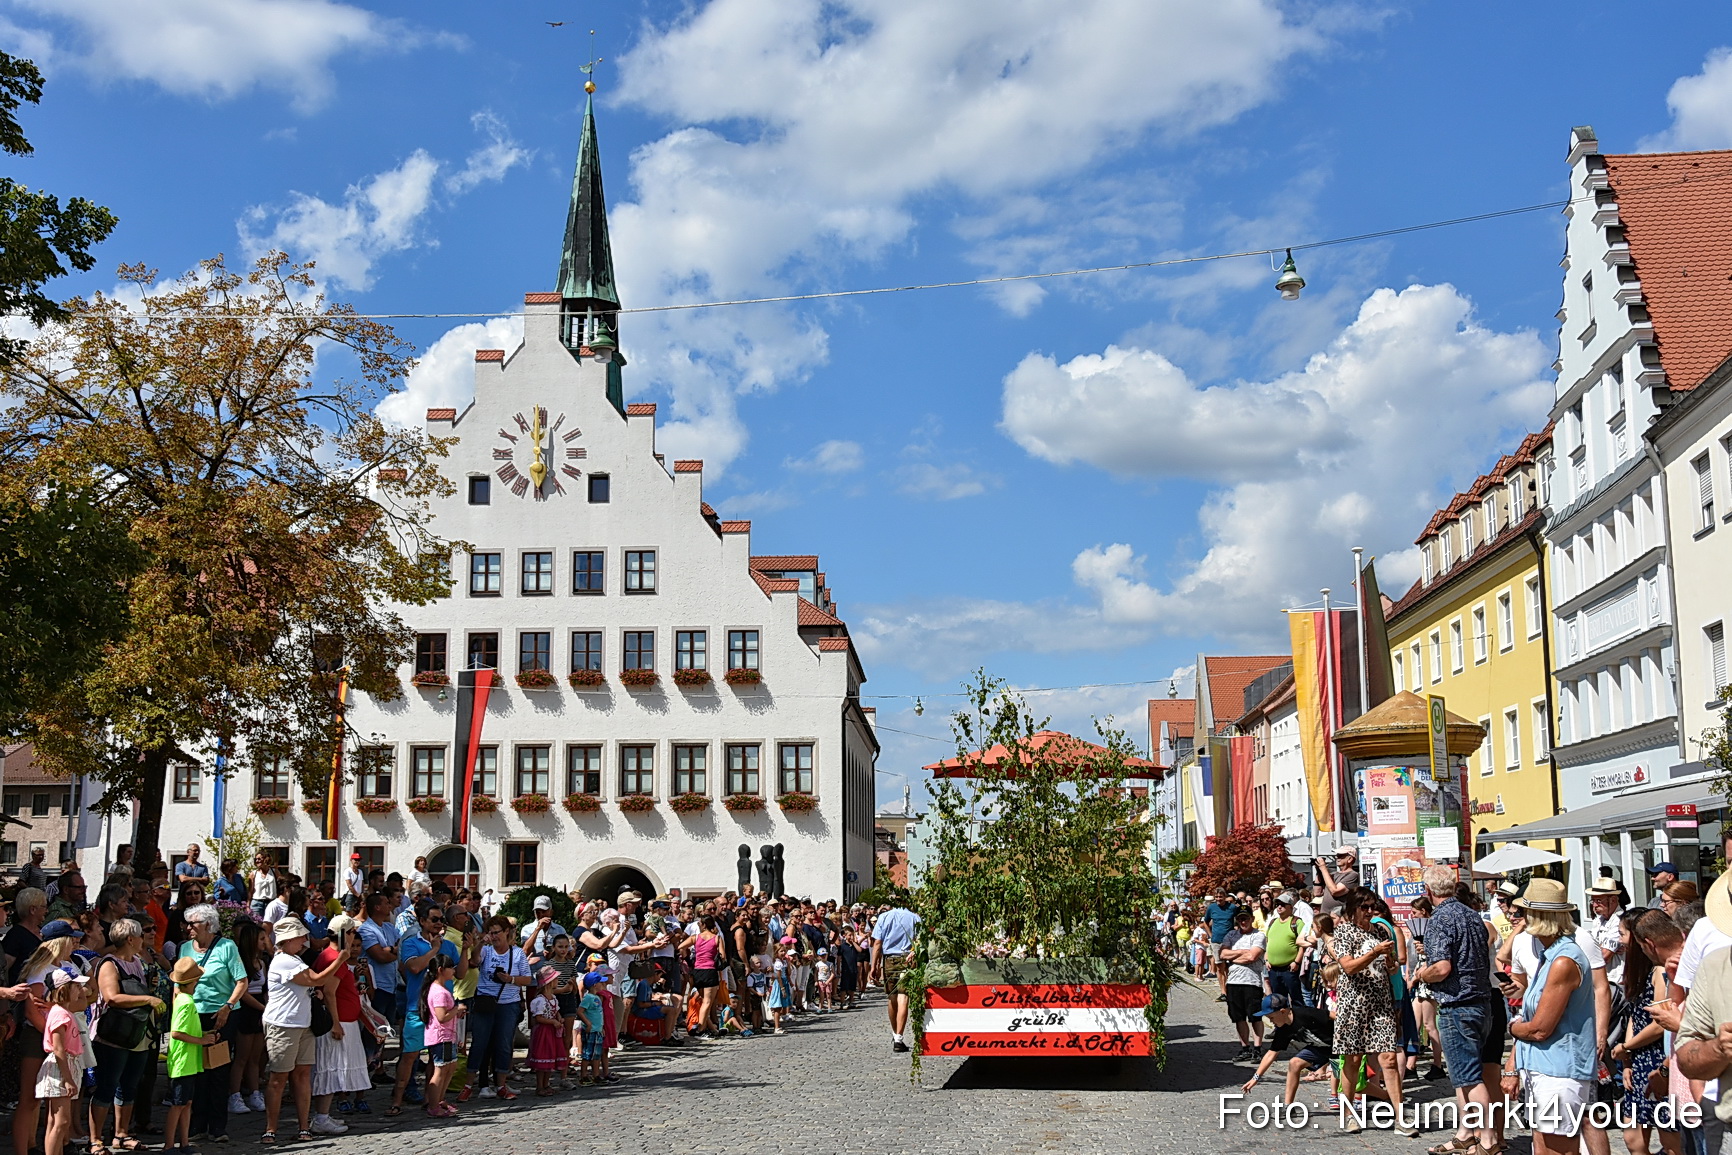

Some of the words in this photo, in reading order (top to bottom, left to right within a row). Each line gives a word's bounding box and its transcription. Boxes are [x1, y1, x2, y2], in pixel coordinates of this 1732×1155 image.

[1386, 883, 1426, 896] VOLKSFE
[1393, 877, 1404, 885] Die
[981, 990, 1092, 1007] Mistelbach
[1007, 1013, 1065, 1032] grüßt
[940, 1035, 1048, 1052] Neumarkt
